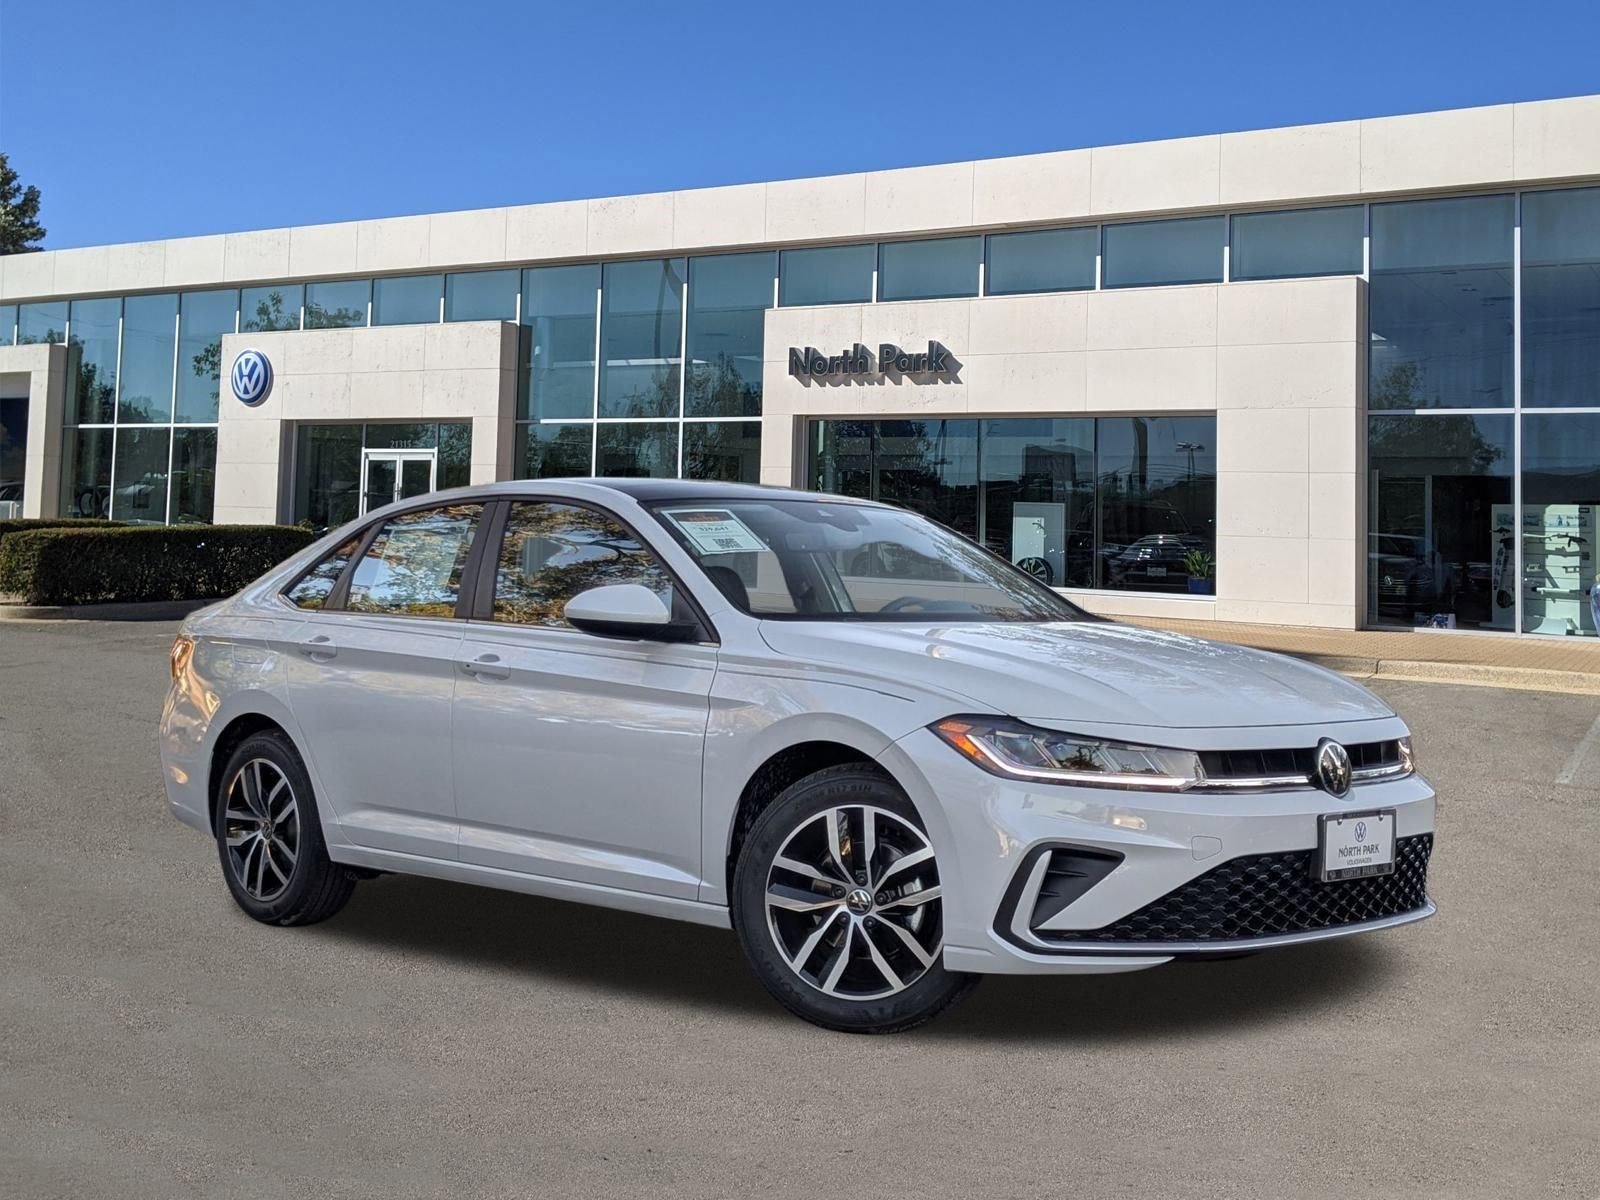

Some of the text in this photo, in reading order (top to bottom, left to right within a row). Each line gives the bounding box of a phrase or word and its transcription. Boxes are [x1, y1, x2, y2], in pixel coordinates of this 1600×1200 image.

[788, 340, 947, 376] North Park
[390, 439, 412, 449] 21315
[1338, 844, 1380, 858] NORTH PARK
